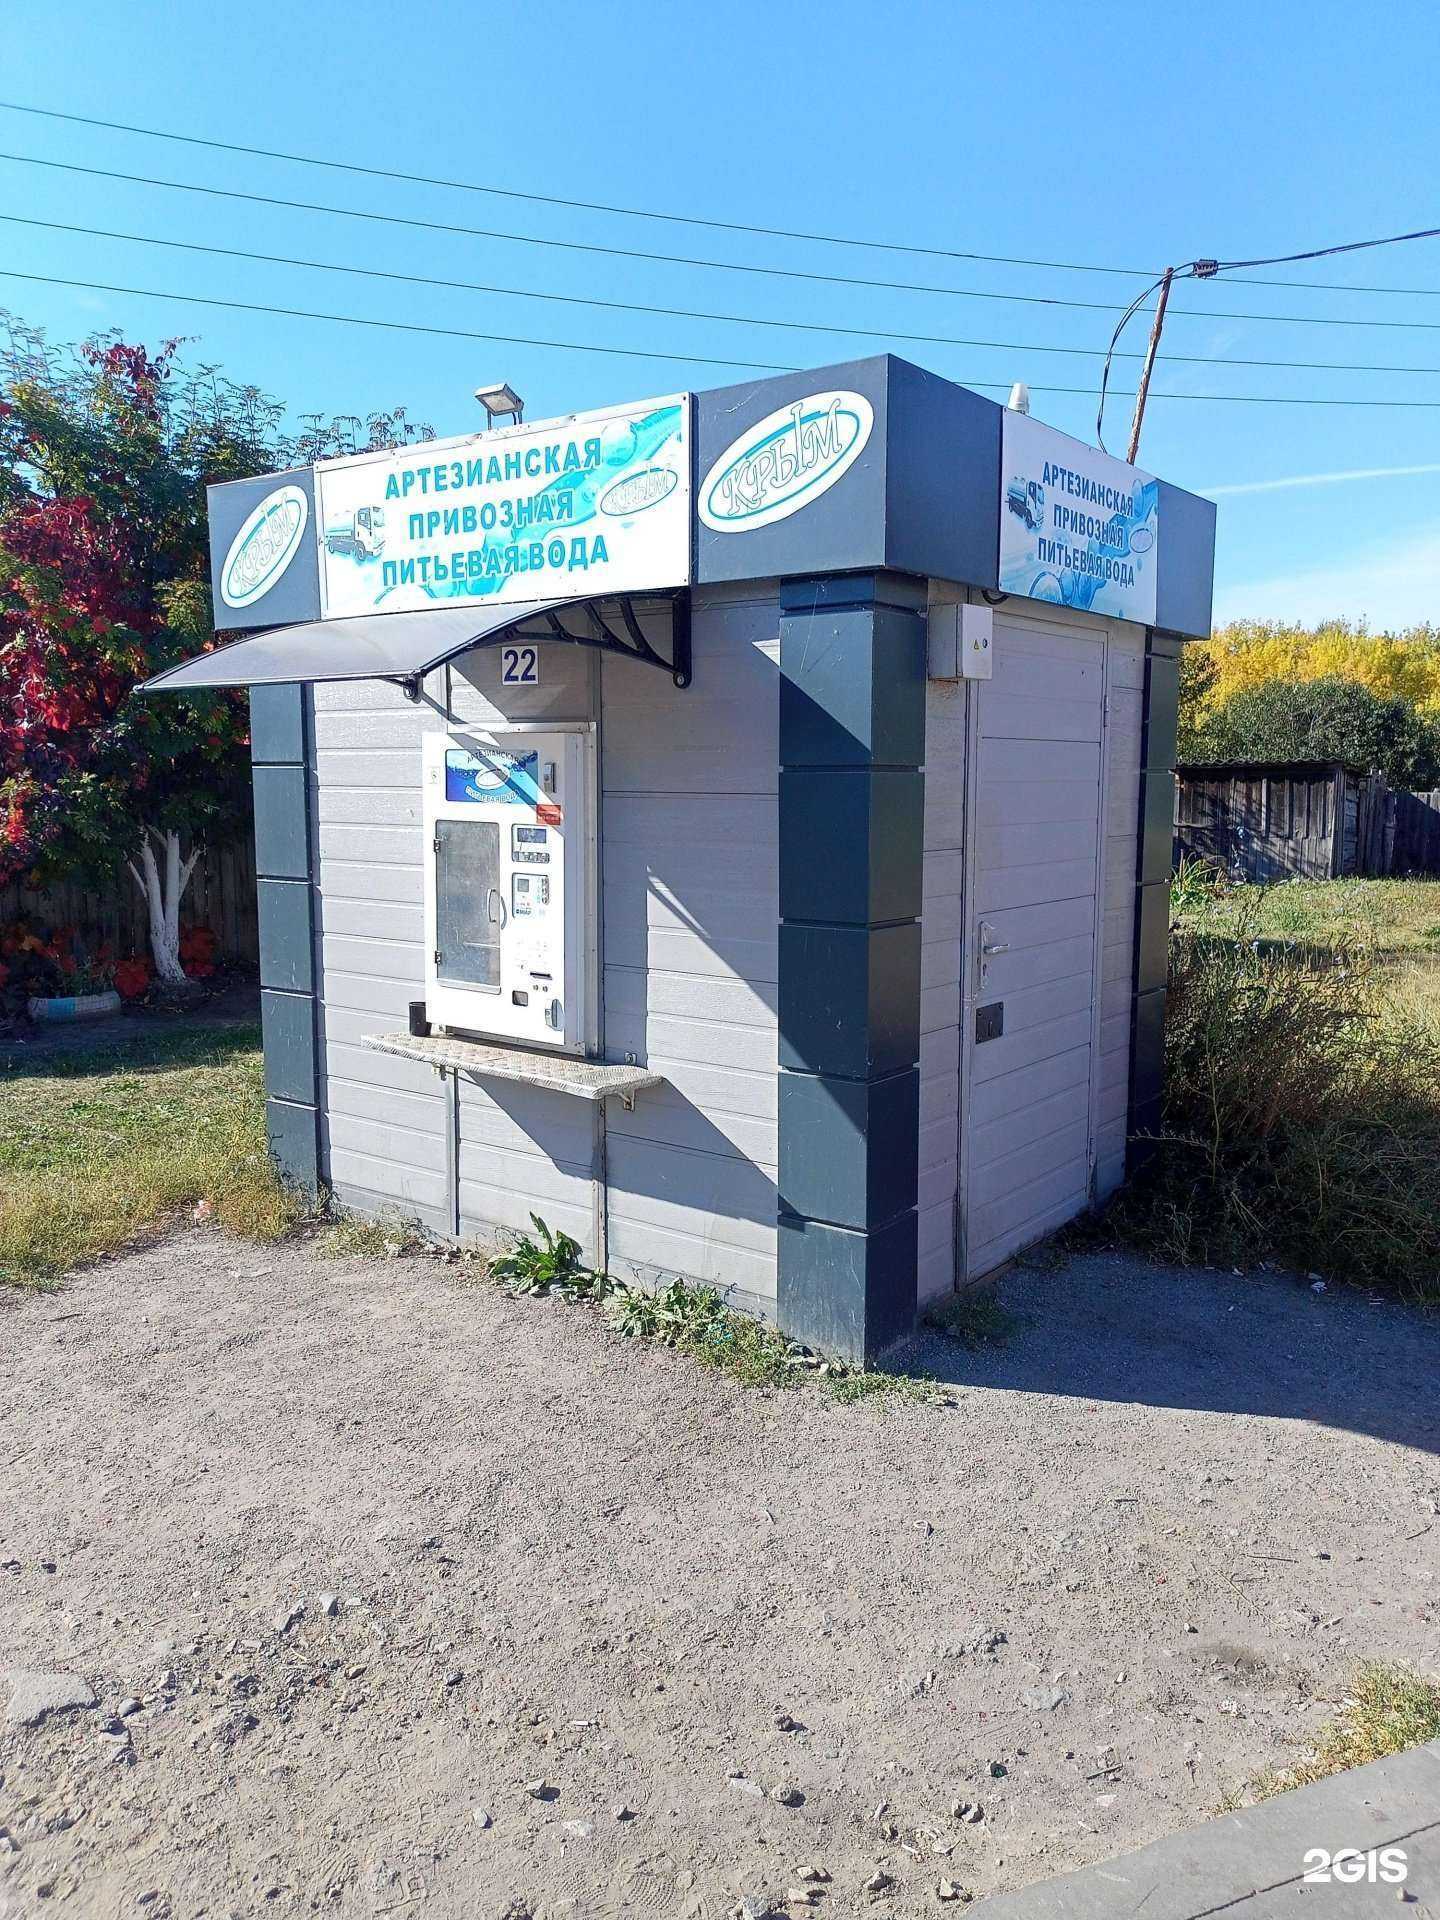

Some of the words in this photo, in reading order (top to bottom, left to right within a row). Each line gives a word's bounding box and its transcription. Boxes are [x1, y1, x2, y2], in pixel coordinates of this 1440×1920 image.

[385, 437, 602, 500] АРТЕЗИАНСКАЯ
[722, 398, 843, 516] КРЫМ
[1042, 461, 1134, 518] АРТЕЗИАНСКАЯ
[408, 490, 574, 541] ПРИВОЗНАЯ
[1053, 504, 1124, 549] ПРИВОЗНАЯ
[383, 542, 521, 587] ПИТЬЕВАЯ
[529, 535, 609, 573] ВОДА
[1038, 538, 1104, 579] ПИТЬЕВАЯ
[1105, 558, 1135, 588] ВОДА
[503, 648, 537, 683] 22
